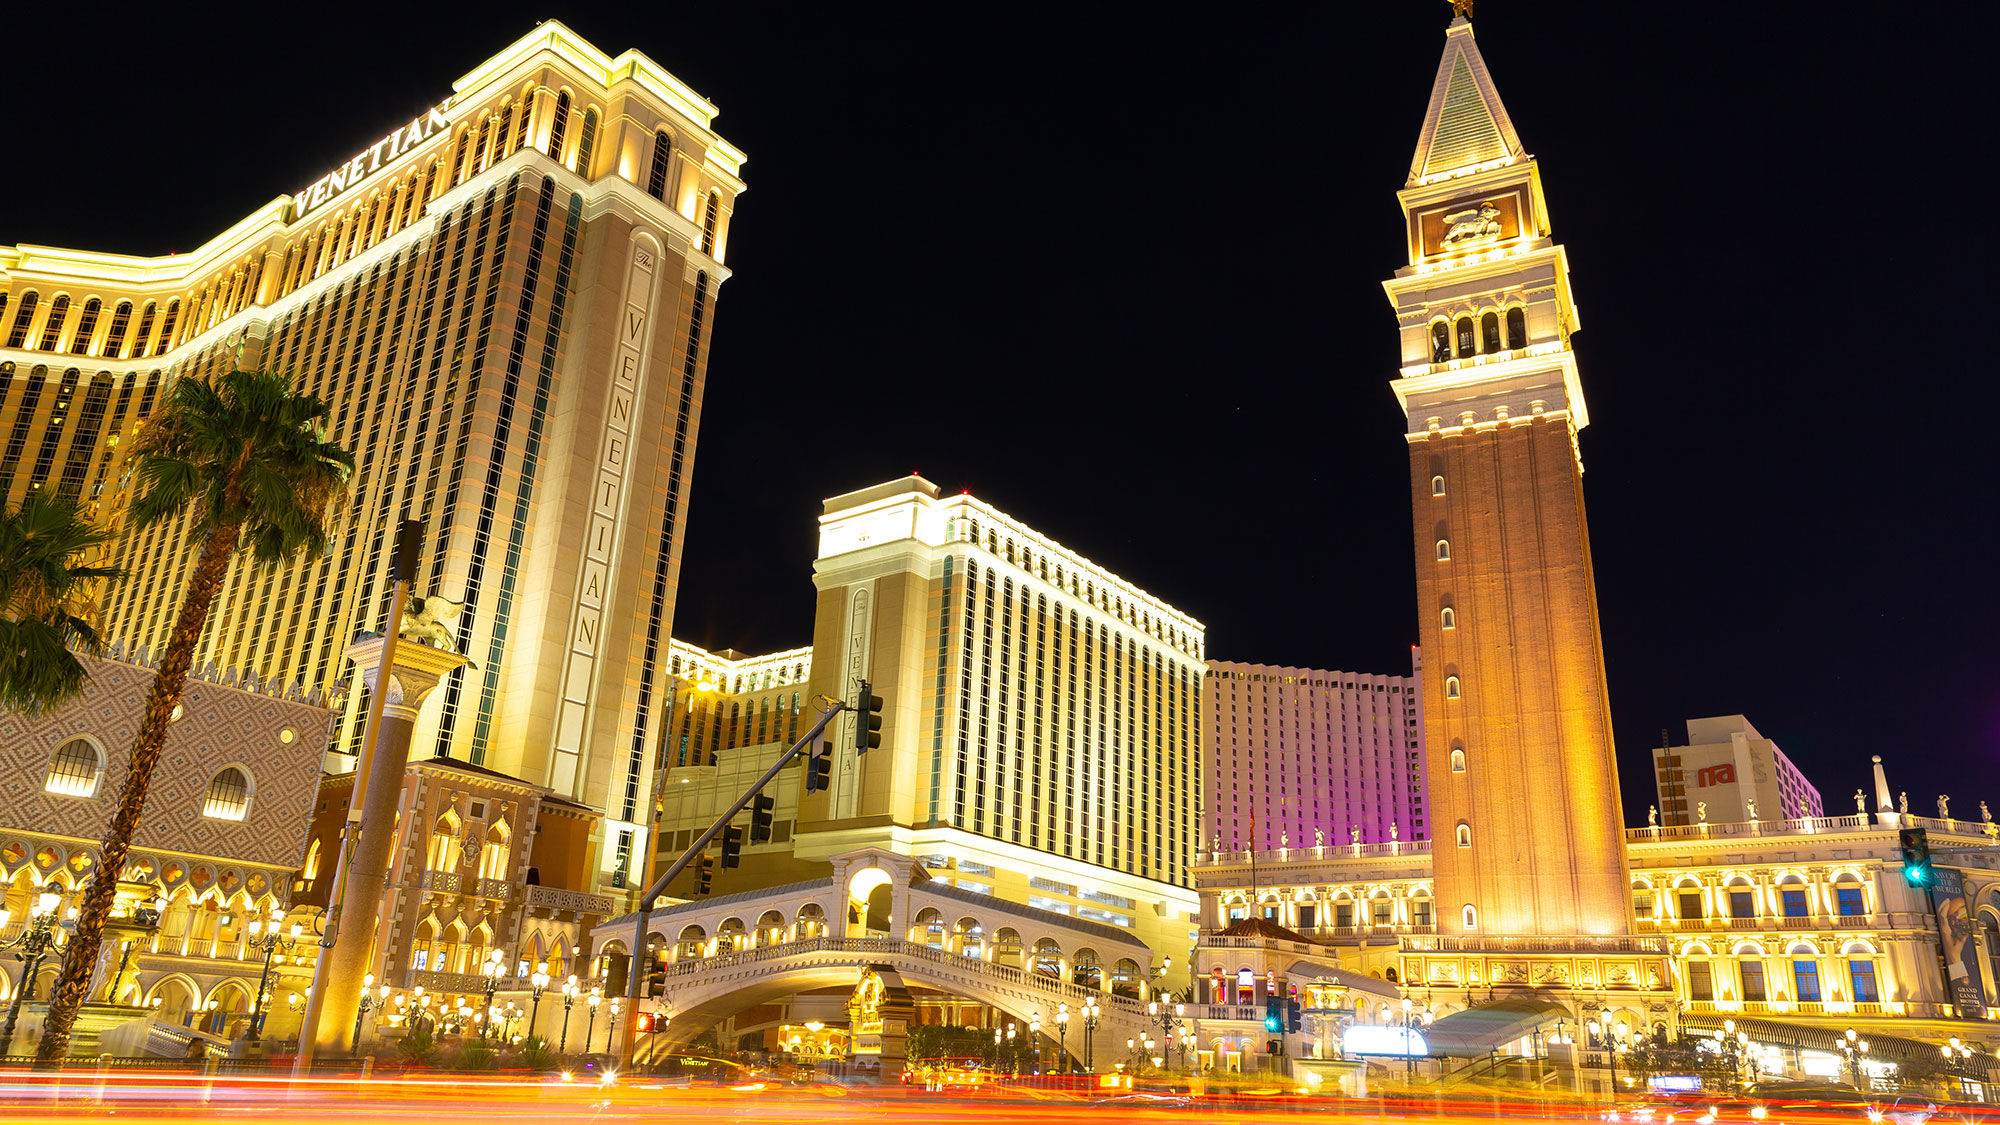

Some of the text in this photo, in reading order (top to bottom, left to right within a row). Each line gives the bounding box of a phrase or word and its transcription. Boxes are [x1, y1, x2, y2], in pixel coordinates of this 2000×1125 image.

[294, 107, 449, 218] VENETIAN
[635, 251, 652, 269] The
[578, 311, 644, 645] VENETIAN
[844, 636, 863, 770] VENEZIA
[1935, 885, 1961, 894] WORLD
[680, 1058, 709, 1066] VENETIAN
